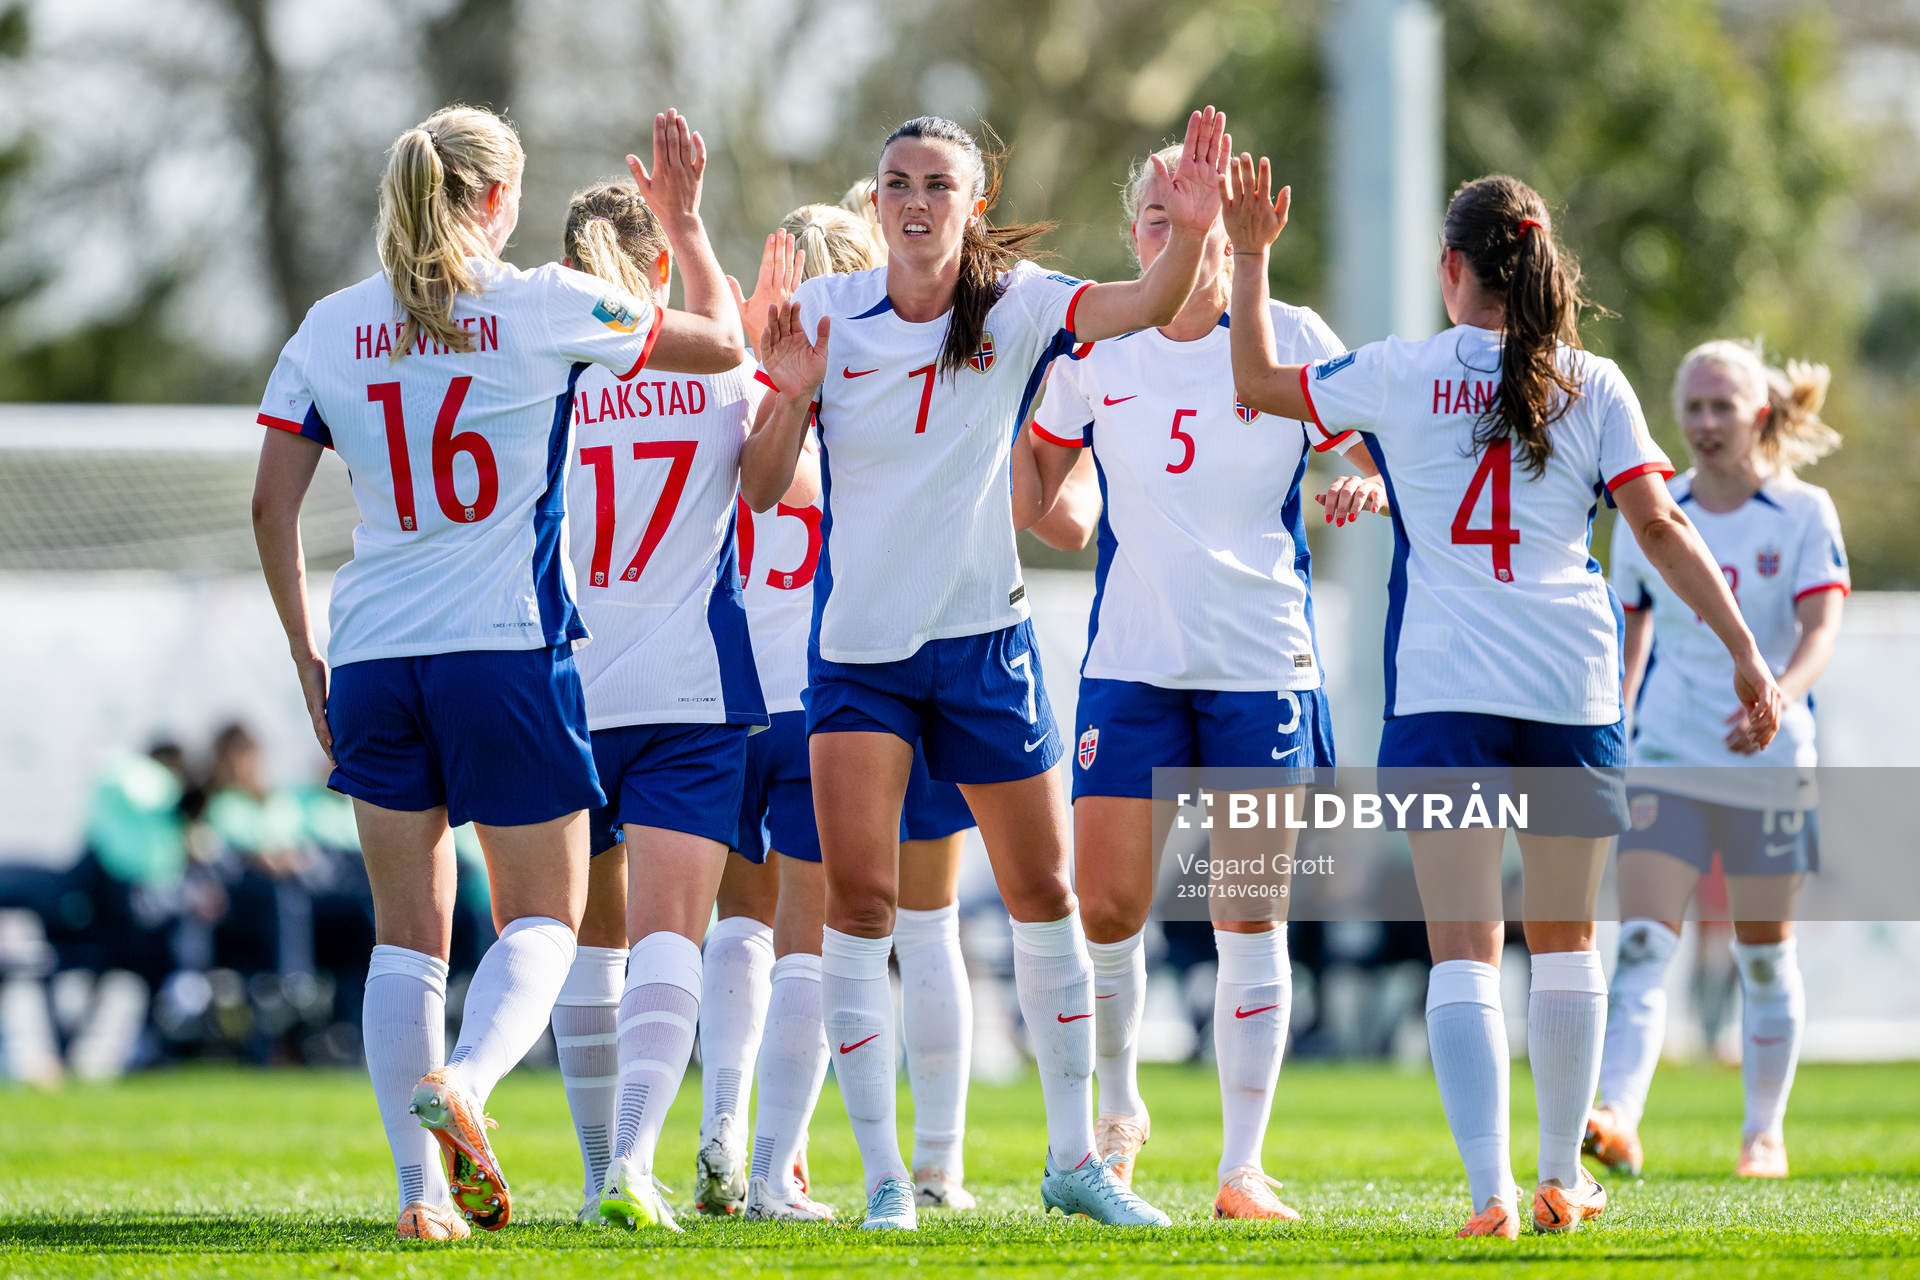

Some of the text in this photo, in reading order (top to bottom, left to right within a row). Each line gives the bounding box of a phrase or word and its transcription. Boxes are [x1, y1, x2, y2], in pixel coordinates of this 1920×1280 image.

[367, 376, 499, 531] 16
[908, 364, 937, 434] 7
[1166, 409, 1197, 474] 5
[579, 440, 699, 588] 17
[1451, 436, 1520, 582] 4
[1009, 651, 1038, 724] 7
